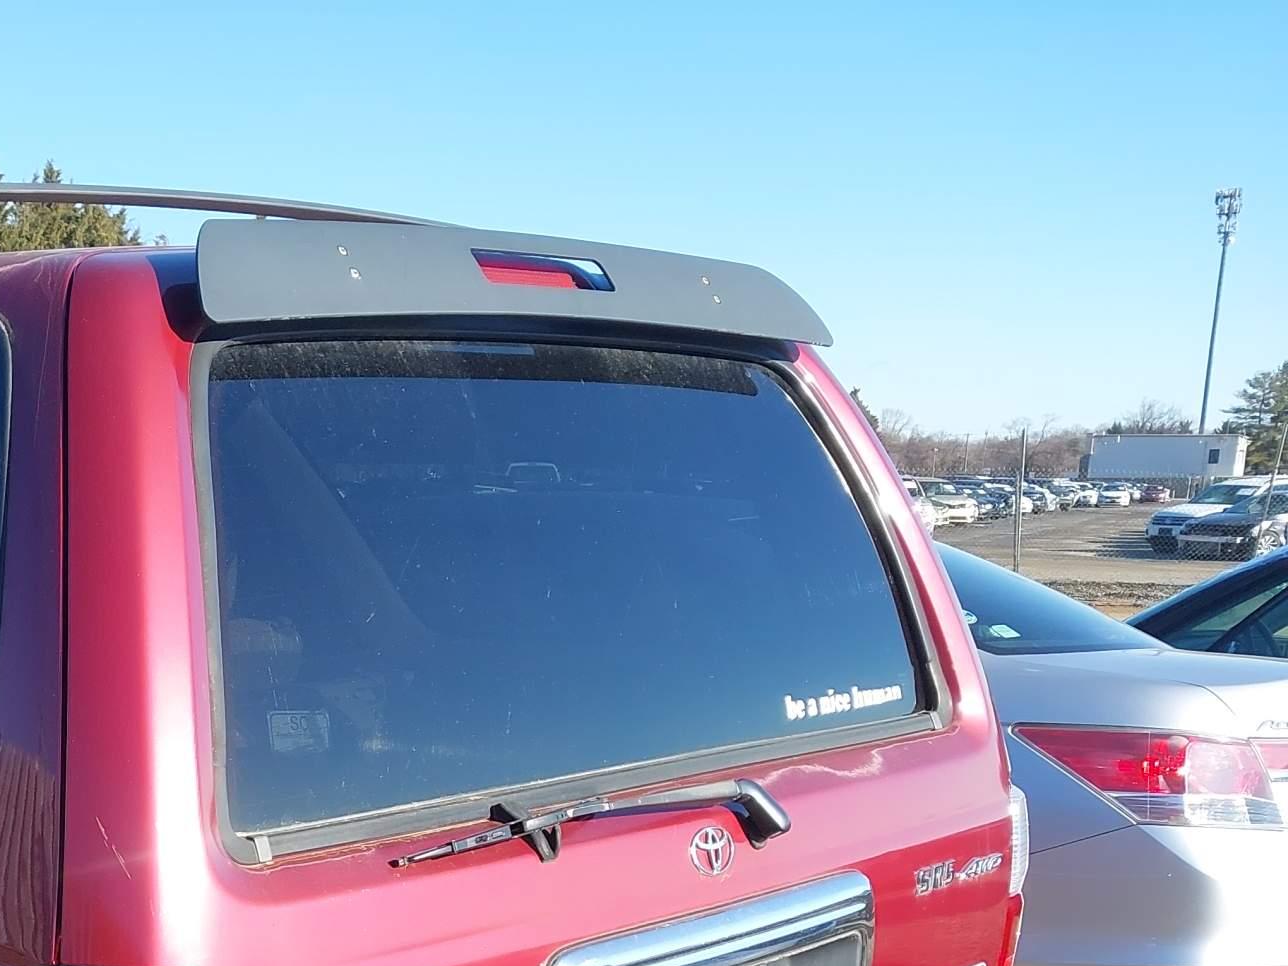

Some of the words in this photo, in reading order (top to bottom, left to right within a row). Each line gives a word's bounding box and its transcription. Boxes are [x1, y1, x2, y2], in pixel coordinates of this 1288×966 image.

[783, 694, 806, 721] be
[807, 697, 818, 718] a
[818, 689, 851, 715] nice
[851, 686, 902, 709] human
